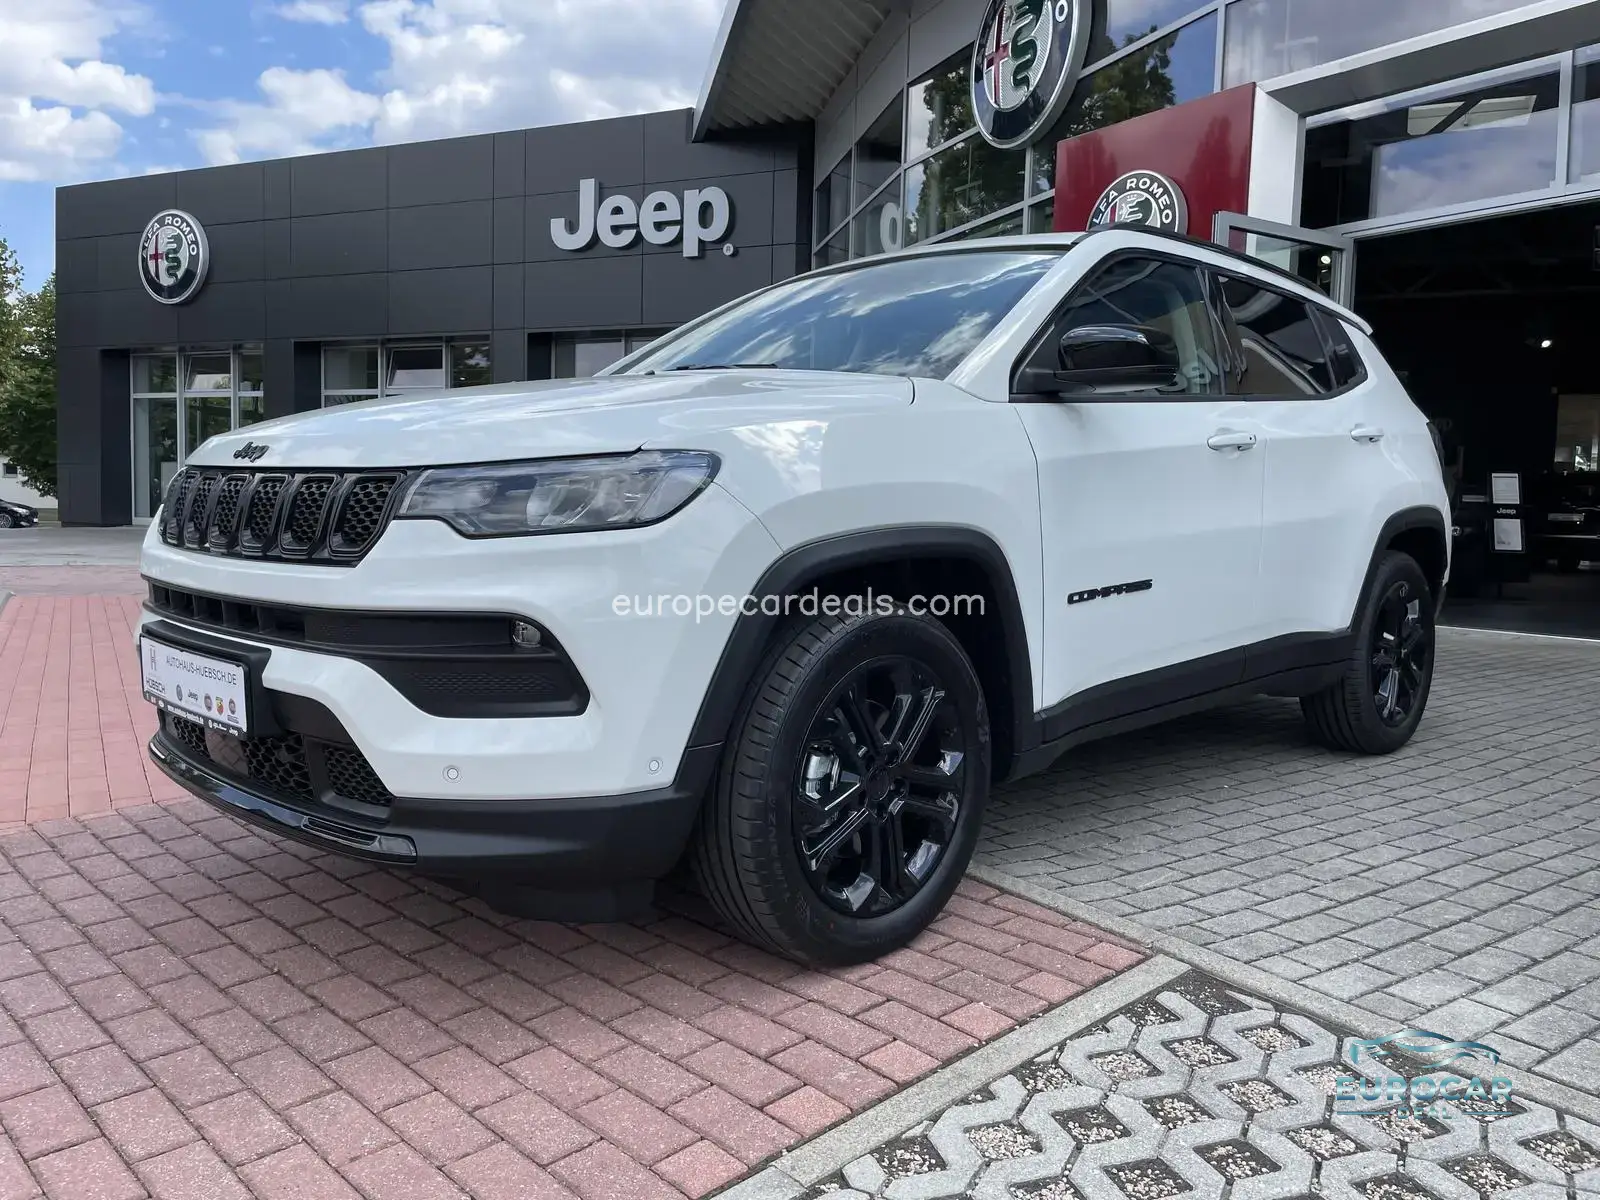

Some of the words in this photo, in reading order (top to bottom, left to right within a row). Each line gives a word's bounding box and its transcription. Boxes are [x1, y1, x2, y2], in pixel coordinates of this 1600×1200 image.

[1092, 189, 1119, 225] LFA
[1126, 177, 1173, 224] ROMEO
[551, 178, 729, 257] Jeep
[142, 222, 160, 258] ALFA
[165, 216, 198, 256] ROMEO
[233, 441, 270, 463] Jeep
[1496, 507, 1517, 515] Jeep
[1067, 579, 1153, 605] COMPASS
[166, 656, 237, 685] AUTOHAUS-HUEBSCH.DE
[187, 688, 199, 701] Jeep
